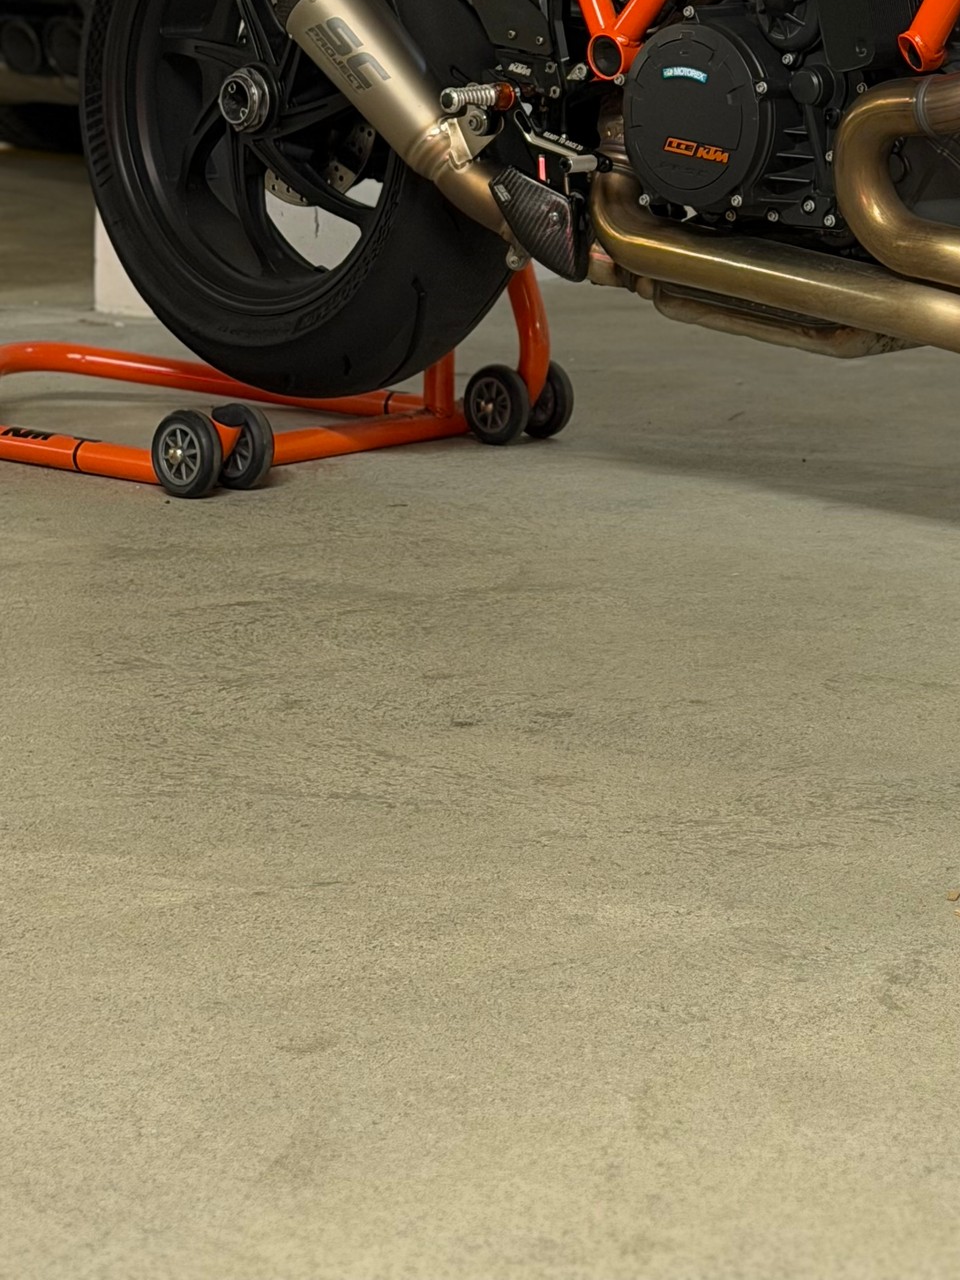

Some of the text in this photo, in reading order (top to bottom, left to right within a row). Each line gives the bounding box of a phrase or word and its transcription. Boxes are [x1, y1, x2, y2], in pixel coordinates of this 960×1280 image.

[305, 26, 366, 92] PROJECT
[315, 16, 392, 90] SC
[508, 62, 531, 76] KTM
[674, 66, 708, 83] MOTOREX
[697, 145, 730, 163] KTM
